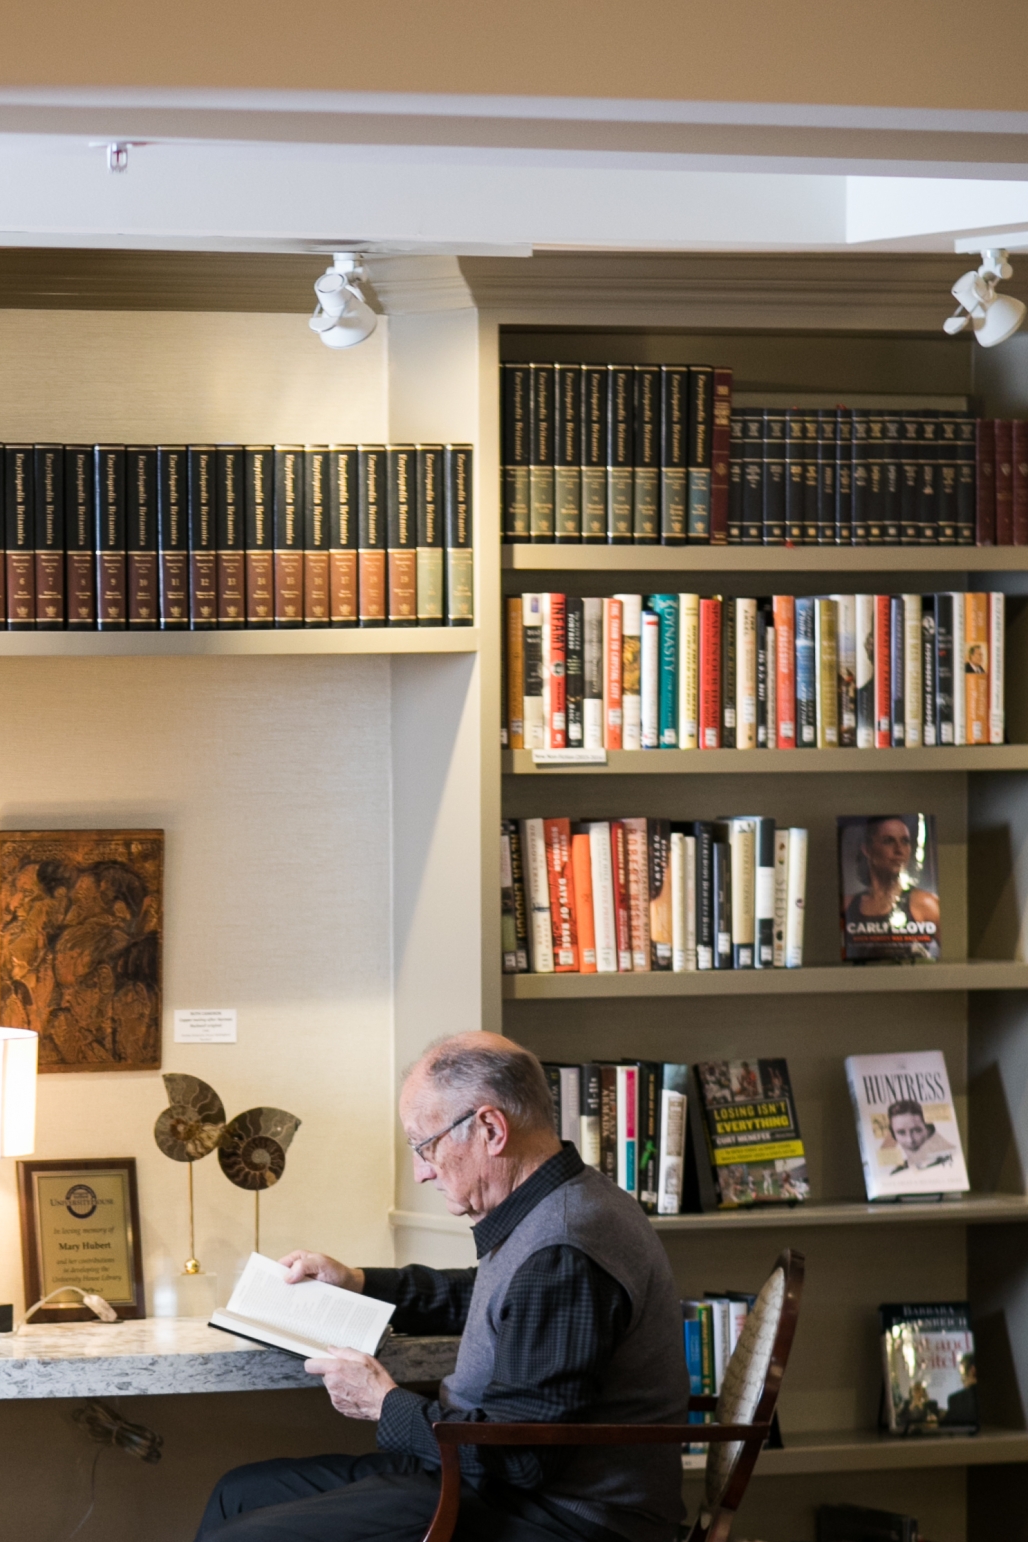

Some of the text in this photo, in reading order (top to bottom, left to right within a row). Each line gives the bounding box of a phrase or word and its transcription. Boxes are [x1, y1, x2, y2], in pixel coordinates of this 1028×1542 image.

[696, 425, 705, 463] Britannica
[16, 505, 25, 545] Britannica
[170, 506, 178, 545] Britannica
[552, 601, 564, 653] INFAMY
[664, 608, 675, 672] DYNASTY
[559, 878, 571, 948] DAYS OF RAGE
[775, 878, 784, 927] SEEDS
[847, 922, 937, 934] CARLI LLOYD
[863, 1072, 945, 1105] HUNTRESS
[713, 1101, 786, 1121] LOSING ISN'T
[716, 1115, 789, 1134] EVERYTHING
[59, 1242, 111, 1251] Mary Hubert
[903, 1306, 955, 1316] BARBARA
